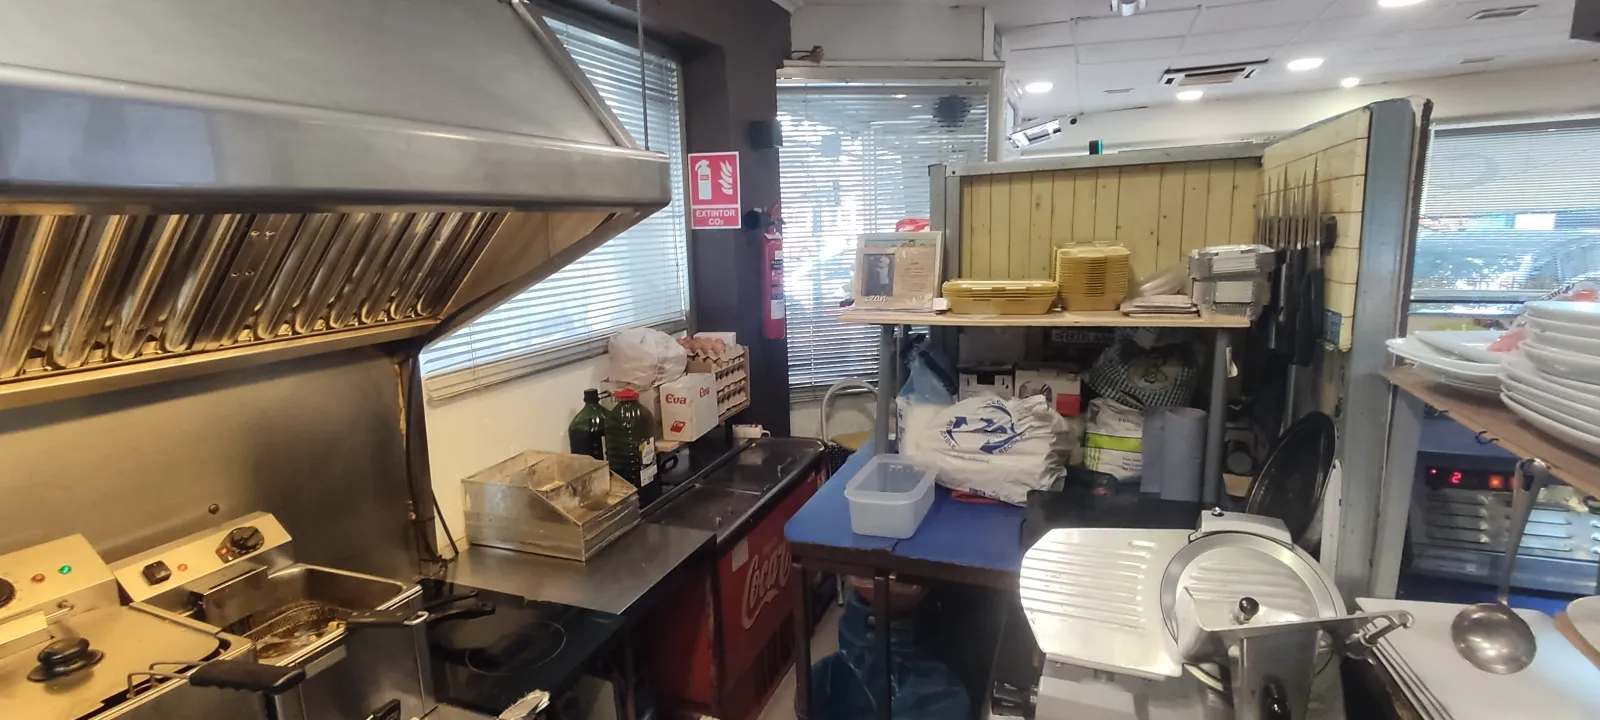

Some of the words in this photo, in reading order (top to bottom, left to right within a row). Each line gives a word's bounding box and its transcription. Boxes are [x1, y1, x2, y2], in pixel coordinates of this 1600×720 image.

[695, 209, 736, 217] EXTINTOR
[699, 387, 710, 398] Eva
[665, 393, 687, 405] Eva
[1452, 471, 1462, 484] 2
